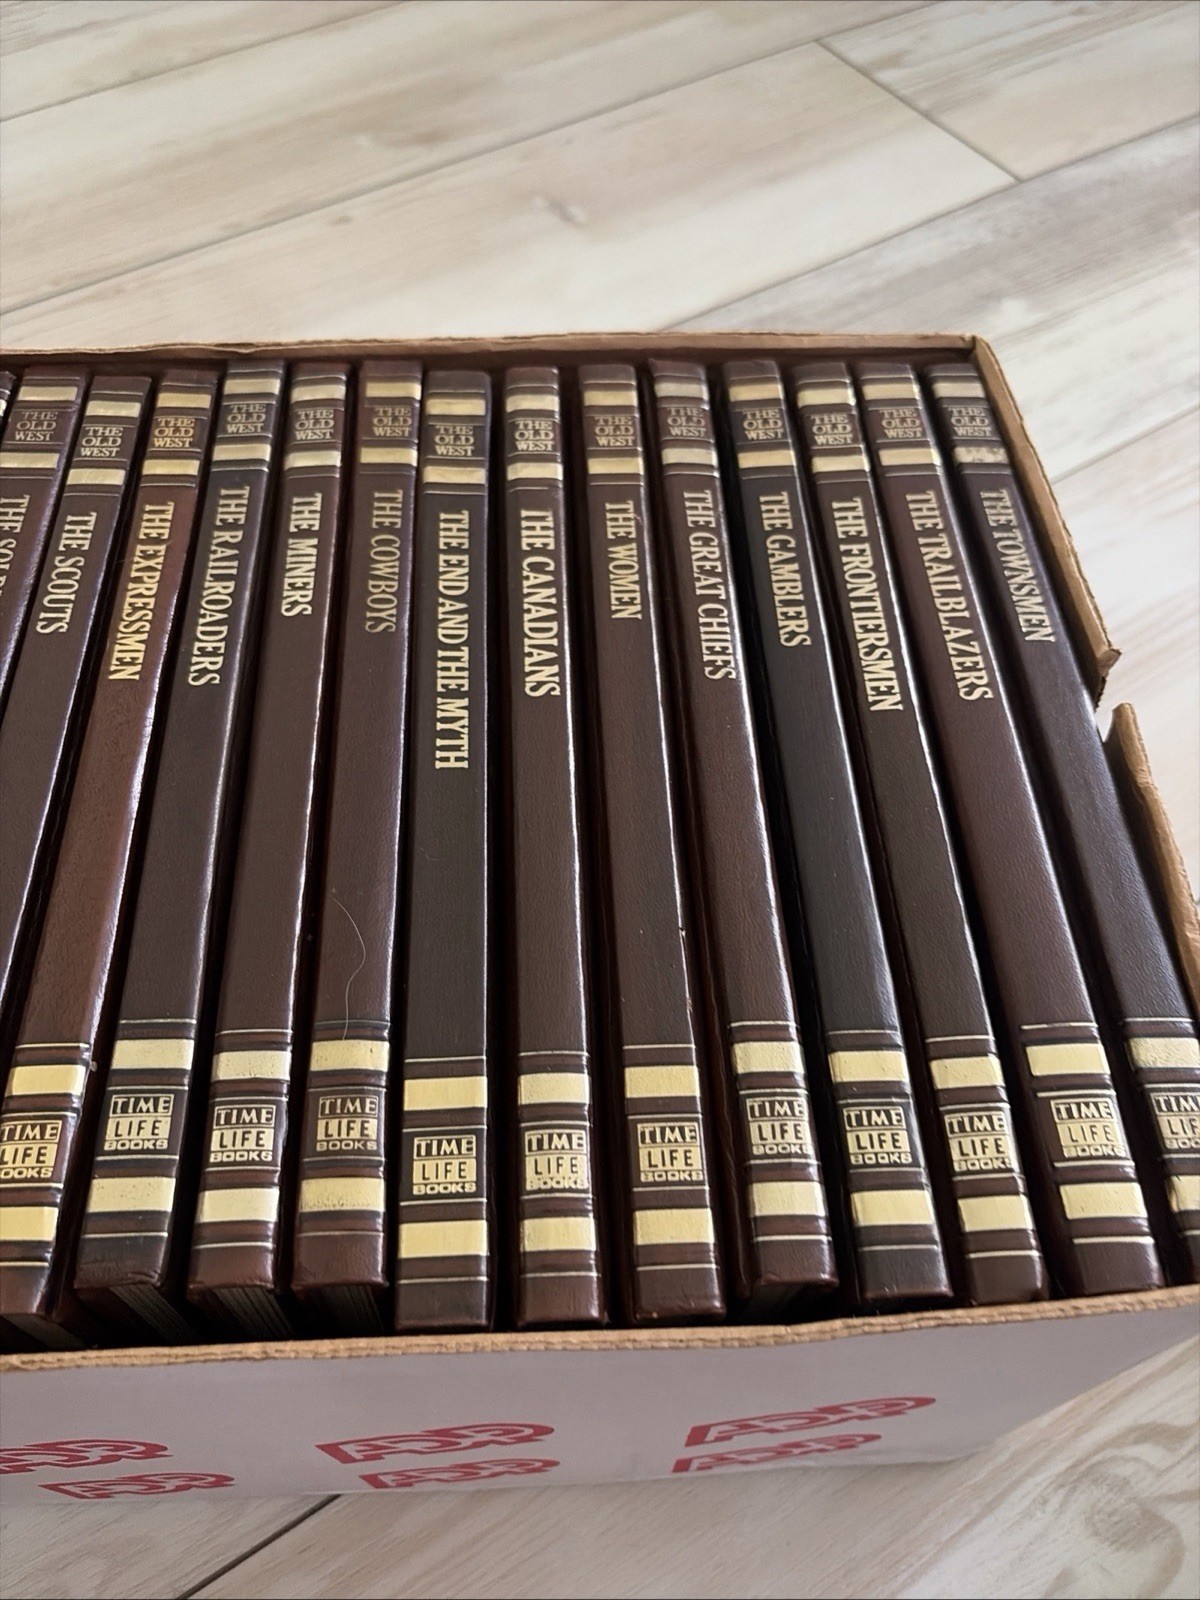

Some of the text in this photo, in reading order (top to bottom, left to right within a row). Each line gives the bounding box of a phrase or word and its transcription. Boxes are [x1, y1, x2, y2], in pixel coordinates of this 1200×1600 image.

[229, 404, 266, 413] THE
[374, 407, 411, 417] THE
[667, 407, 703, 416] THE
[743, 409, 780, 419] THE
[880, 408, 917, 417] THE
[949, 406, 986, 416] THE
[22, 412, 58, 421] THE
[227, 413, 266, 423] OLD
[298, 410, 334, 419] THE
[811, 414, 848, 423] THE
[16, 420, 56, 431] OLD
[157, 418, 194, 427] THE
[295, 419, 334, 429] OLD
[373, 416, 412, 427] OLD
[515, 420, 552, 430] THE
[594, 416, 633, 425] THE
[667, 416, 705, 427] OLD
[744, 419, 782, 429] OLD
[882, 417, 921, 428] OLD
[950, 416, 989, 426] OLD
[85, 427, 122, 436] THE
[155, 427, 193, 437] OLD
[227, 423, 264, 433] WEST
[373, 426, 410, 437] WEST
[435, 426, 474, 434] THE
[595, 425, 634, 435] OLD
[669, 427, 706, 437] WEST
[812, 423, 852, 434] OLD
[883, 428, 923, 438] WEST
[952, 426, 992, 437] WEST
[15, 431, 52, 441] WEST
[295, 429, 332, 439] WEST
[434, 434, 474, 445] OLD
[515, 430, 553, 440] OLD
[745, 429, 783, 439] WEST
[814, 434, 853, 445] WEST
[81, 437, 121, 447] OLD
[154, 438, 192, 448] WEST
[515, 440, 553, 451] WEST
[596, 436, 634, 447] WEST
[80, 448, 120, 458] WEST
[435, 445, 475, 456] WEST
[0, 494, 30, 533] THE
[281, 493, 322, 617] THE MINERS
[605, 500, 642, 620] THE WOMEN
[365, 489, 403, 634] THE COWBOYS
[980, 490, 1055, 642] THE TOWNSMEN
[36, 512, 97, 634] THE SCOUTS
[759, 492, 811, 647] THE GAMBLERS
[188, 486, 250, 686] THE RAILROADERS
[683, 490, 736, 680] THE GREAT CHIEFS
[107, 502, 174, 681] THE EXPRESSMEN
[906, 491, 993, 701] THE TRAILBLAZERS
[520, 509, 561, 698] THE CANADIANS
[832, 498, 903, 712] THE FRONTIERSMEN
[435, 510, 469, 770] THE END AND THE MYTH
[112, 1096, 171, 1114] TIME
[321, 1097, 377, 1114] TIME
[749, 1098, 807, 1118] TIME
[1154, 1096, 1200, 1112] TIM
[217, 1108, 273, 1124] TIME
[1056, 1101, 1113, 1120] TIME
[845, 1109, 903, 1127] TIME
[947, 1114, 1006, 1133] TIME
[113, 1119, 161, 1136] LIFE
[323, 1120, 371, 1138] LIFE
[757, 1122, 804, 1141] LIFE
[1167, 1118, 1200, 1135] LIF
[2, 1124, 59, 1141] TIME
[639, 1125, 698, 1144] TIME
[1069, 1124, 1115, 1143] LIFE
[104, 1138, 168, 1150] BOOKS
[218, 1130, 265, 1148] LIFE
[528, 1133, 585, 1151] TIME
[855, 1132, 901, 1150] LIFE
[317, 1141, 377, 1151] BOOKS
[417, 1138, 474, 1156] TIME
[752, 1143, 812, 1156] BOOKS
[958, 1136, 1006, 1155] LIFE
[1064, 1145, 1125, 1157] BOOKS
[0, 1146, 48, 1165] LIFE
[210, 1151, 272, 1162] BOOKS
[647, 1149, 693, 1167] LIFE
[851, 1153, 912, 1164] BOOKS
[421, 1161, 468, 1180] LIFE
[534, 1156, 579, 1175] LIFE
[0, 1167, 53, 1179] OOKS
[641, 1171, 703, 1181] BOOKS
[413, 1182, 476, 1194] BOOKS
[526, 1177, 588, 1190] BOOKS
